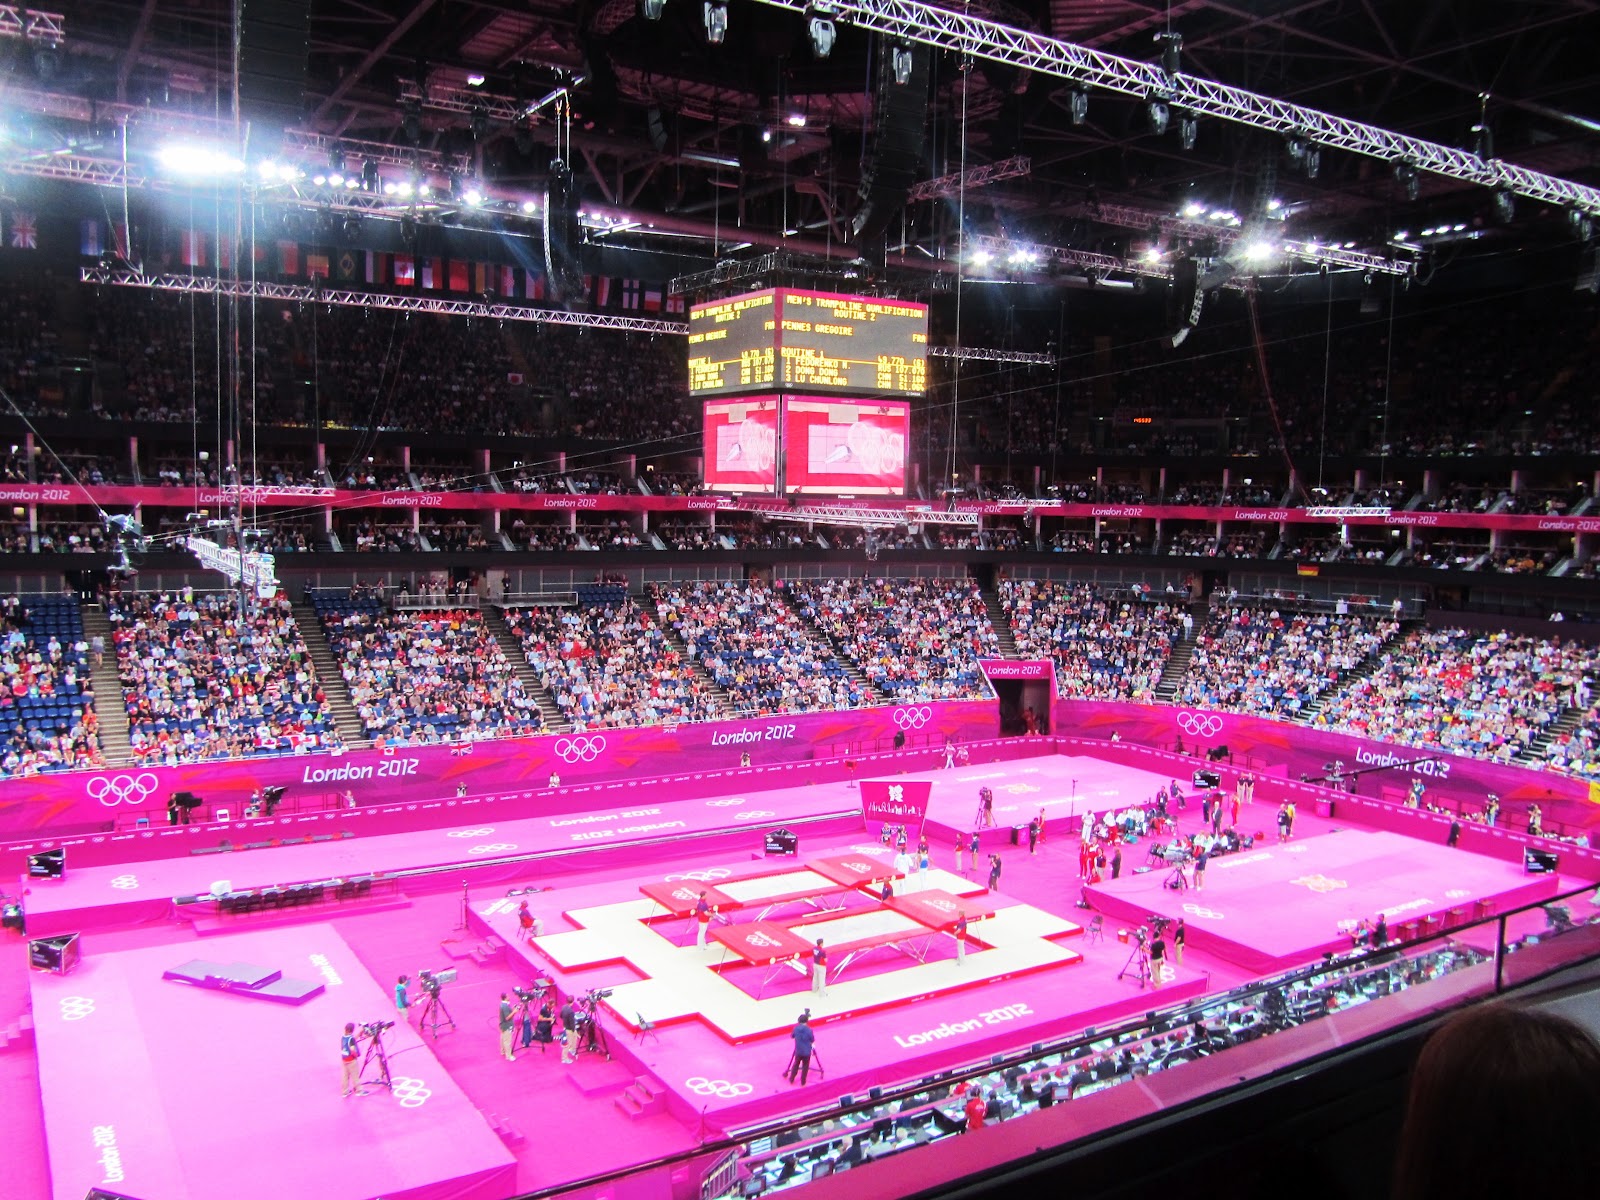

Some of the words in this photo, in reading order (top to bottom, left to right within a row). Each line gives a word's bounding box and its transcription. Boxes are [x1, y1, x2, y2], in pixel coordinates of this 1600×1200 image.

[786, 295, 812, 306] MEN'S
[816, 298, 862, 312] TRAMPOLINE
[866, 304, 923, 318] QUALIFICATION
[834, 309, 866, 321] ROUTINE
[870, 313, 876, 321] 2
[781, 321, 811, 332] PENNES
[815, 324, 853, 336] GREGOIRE
[912, 333, 926, 343] FRA
[781, 347, 816, 358] ROUTINE
[820, 351, 824, 359] 1
[786, 357, 791, 365] 1
[785, 365, 791, 373] 2
[795, 365, 815, 375] DONG
[819, 367, 838, 377] DONG
[785, 373, 791, 382] 3
[795, 374, 806, 383] LU
[809, 375, 848, 386] CHUNLONG
[0, 488, 39, 500] ondon
[42, 489, 70, 500] 2012
[382, 495, 419, 505] London
[420, 495, 443, 505] 2012
[544, 497, 576, 507] London
[577, 498, 597, 507] 2012
[687, 499, 716, 509] London
[1091, 507, 1122, 516] London
[1123, 507, 1143, 516] 2012
[1235, 510, 1267, 520] London
[1268, 511, 1288, 520] 2012
[1384, 514, 1416, 524] London
[1418, 515, 1438, 525] 2012
[1538, 519, 1575, 529] London
[1576, 520, 1600, 531] 2012
[988, 665, 1020, 675] London
[1021, 665, 1042, 675] 2012
[711, 727, 762, 746] London
[764, 724, 796, 741] 2012
[1355, 746, 1409, 771] London
[303, 761, 373, 783] London
[377, 758, 420, 777] 2012
[550, 814, 619, 827] London
[620, 808, 662, 818] 2012
[617, 820, 687, 834] London
[570, 830, 616, 841] 2012
[893, 1022, 983, 1048] London
[978, 1003, 1034, 1025] 2012
[97, 1147, 125, 1184] London
